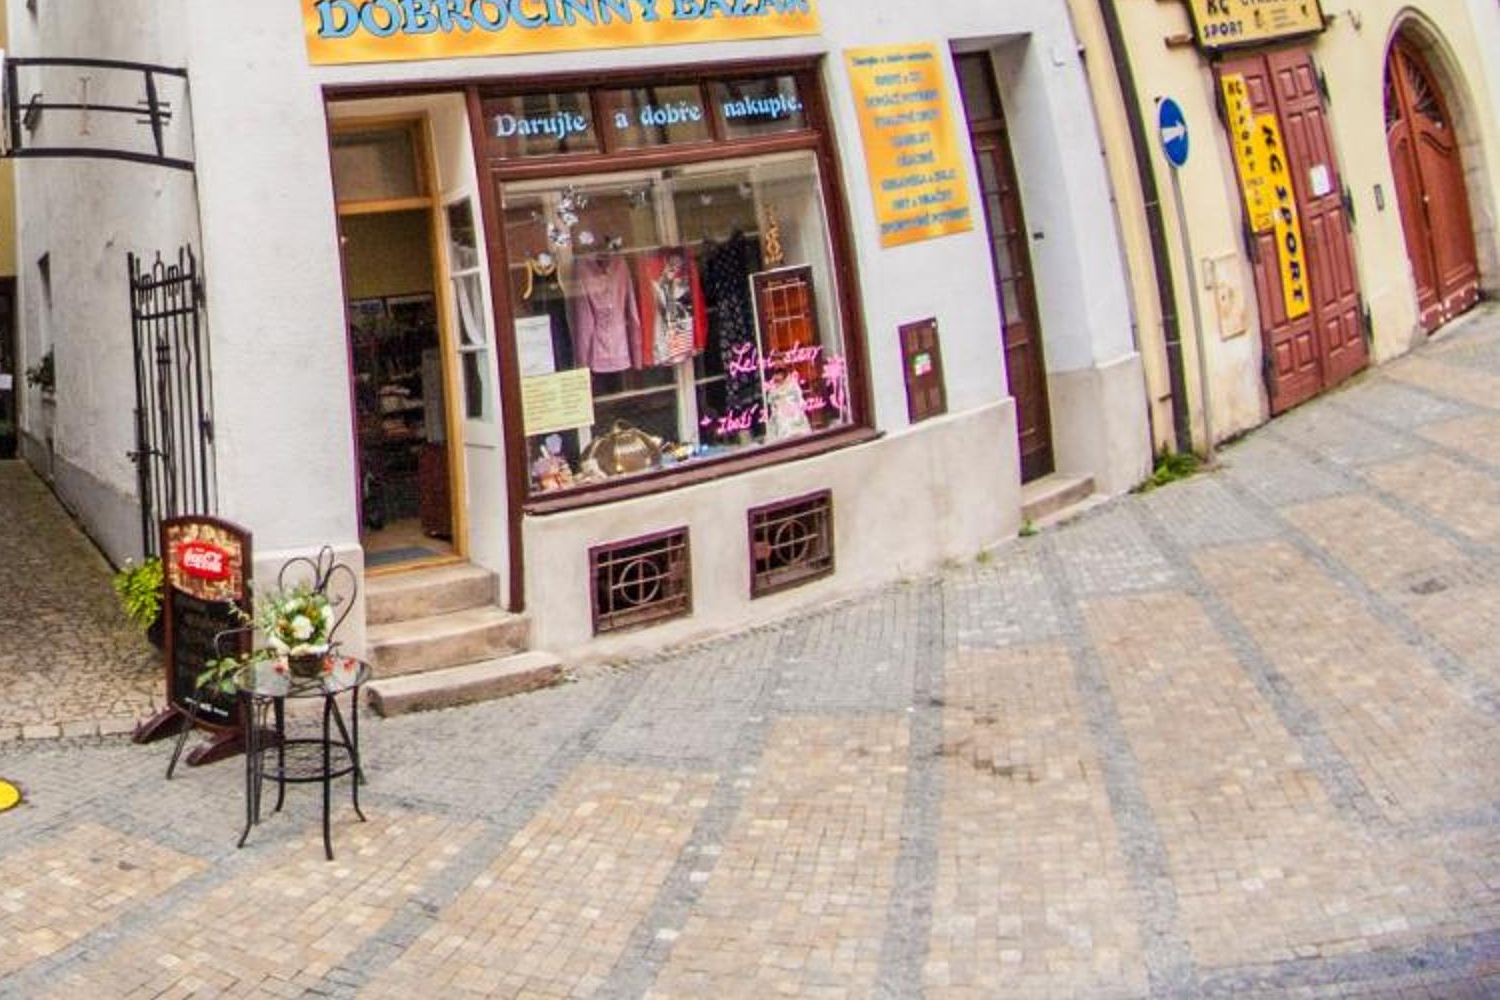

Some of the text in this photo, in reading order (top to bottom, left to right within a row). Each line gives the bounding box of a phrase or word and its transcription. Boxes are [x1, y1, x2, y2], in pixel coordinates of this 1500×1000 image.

[1203, 19, 1243, 39] SPORT
[495, 112, 587, 139] Darujte
[614, 112, 629, 129] a
[640, 100, 703, 127] dobře
[1274, 184, 1304, 302] SPORT
